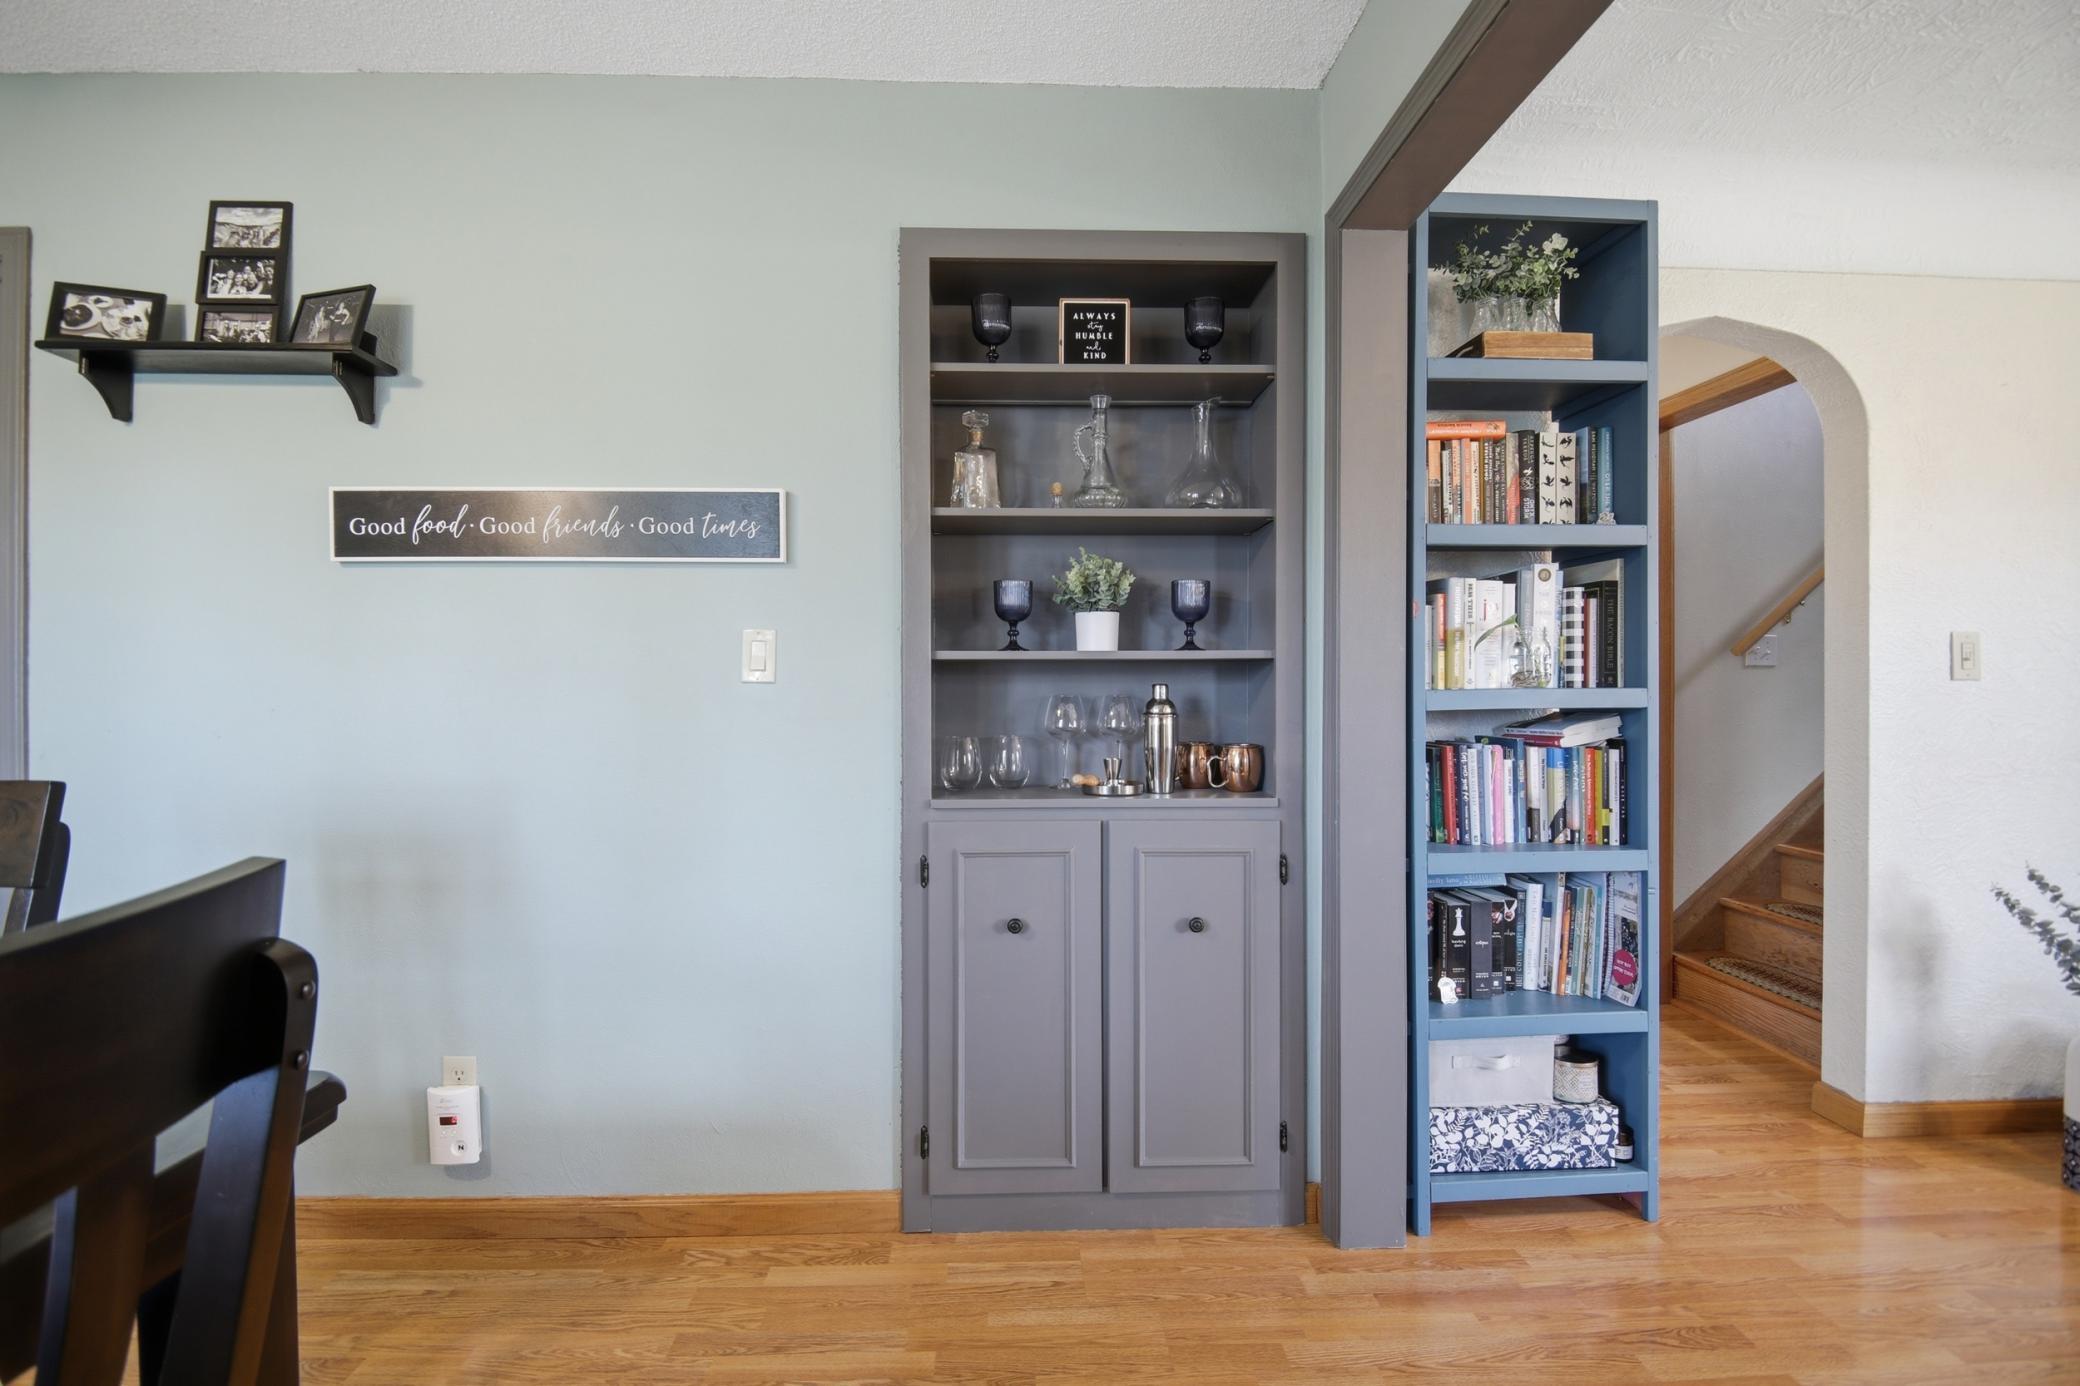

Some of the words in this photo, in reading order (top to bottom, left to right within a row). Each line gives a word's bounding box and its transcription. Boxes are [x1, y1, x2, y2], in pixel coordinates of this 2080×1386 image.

[1073, 312, 1116, 320] ALWAYS
[1087, 321, 1104, 332] stay
[1075, 332, 1113, 340] HUMBLE
[349, 516, 406, 536] Good
[412, 504, 467, 544] food
[480, 516, 535, 535] Good
[543, 505, 624, 544] friends
[638, 517, 695, 535] Good
[701, 510, 761, 539] times
